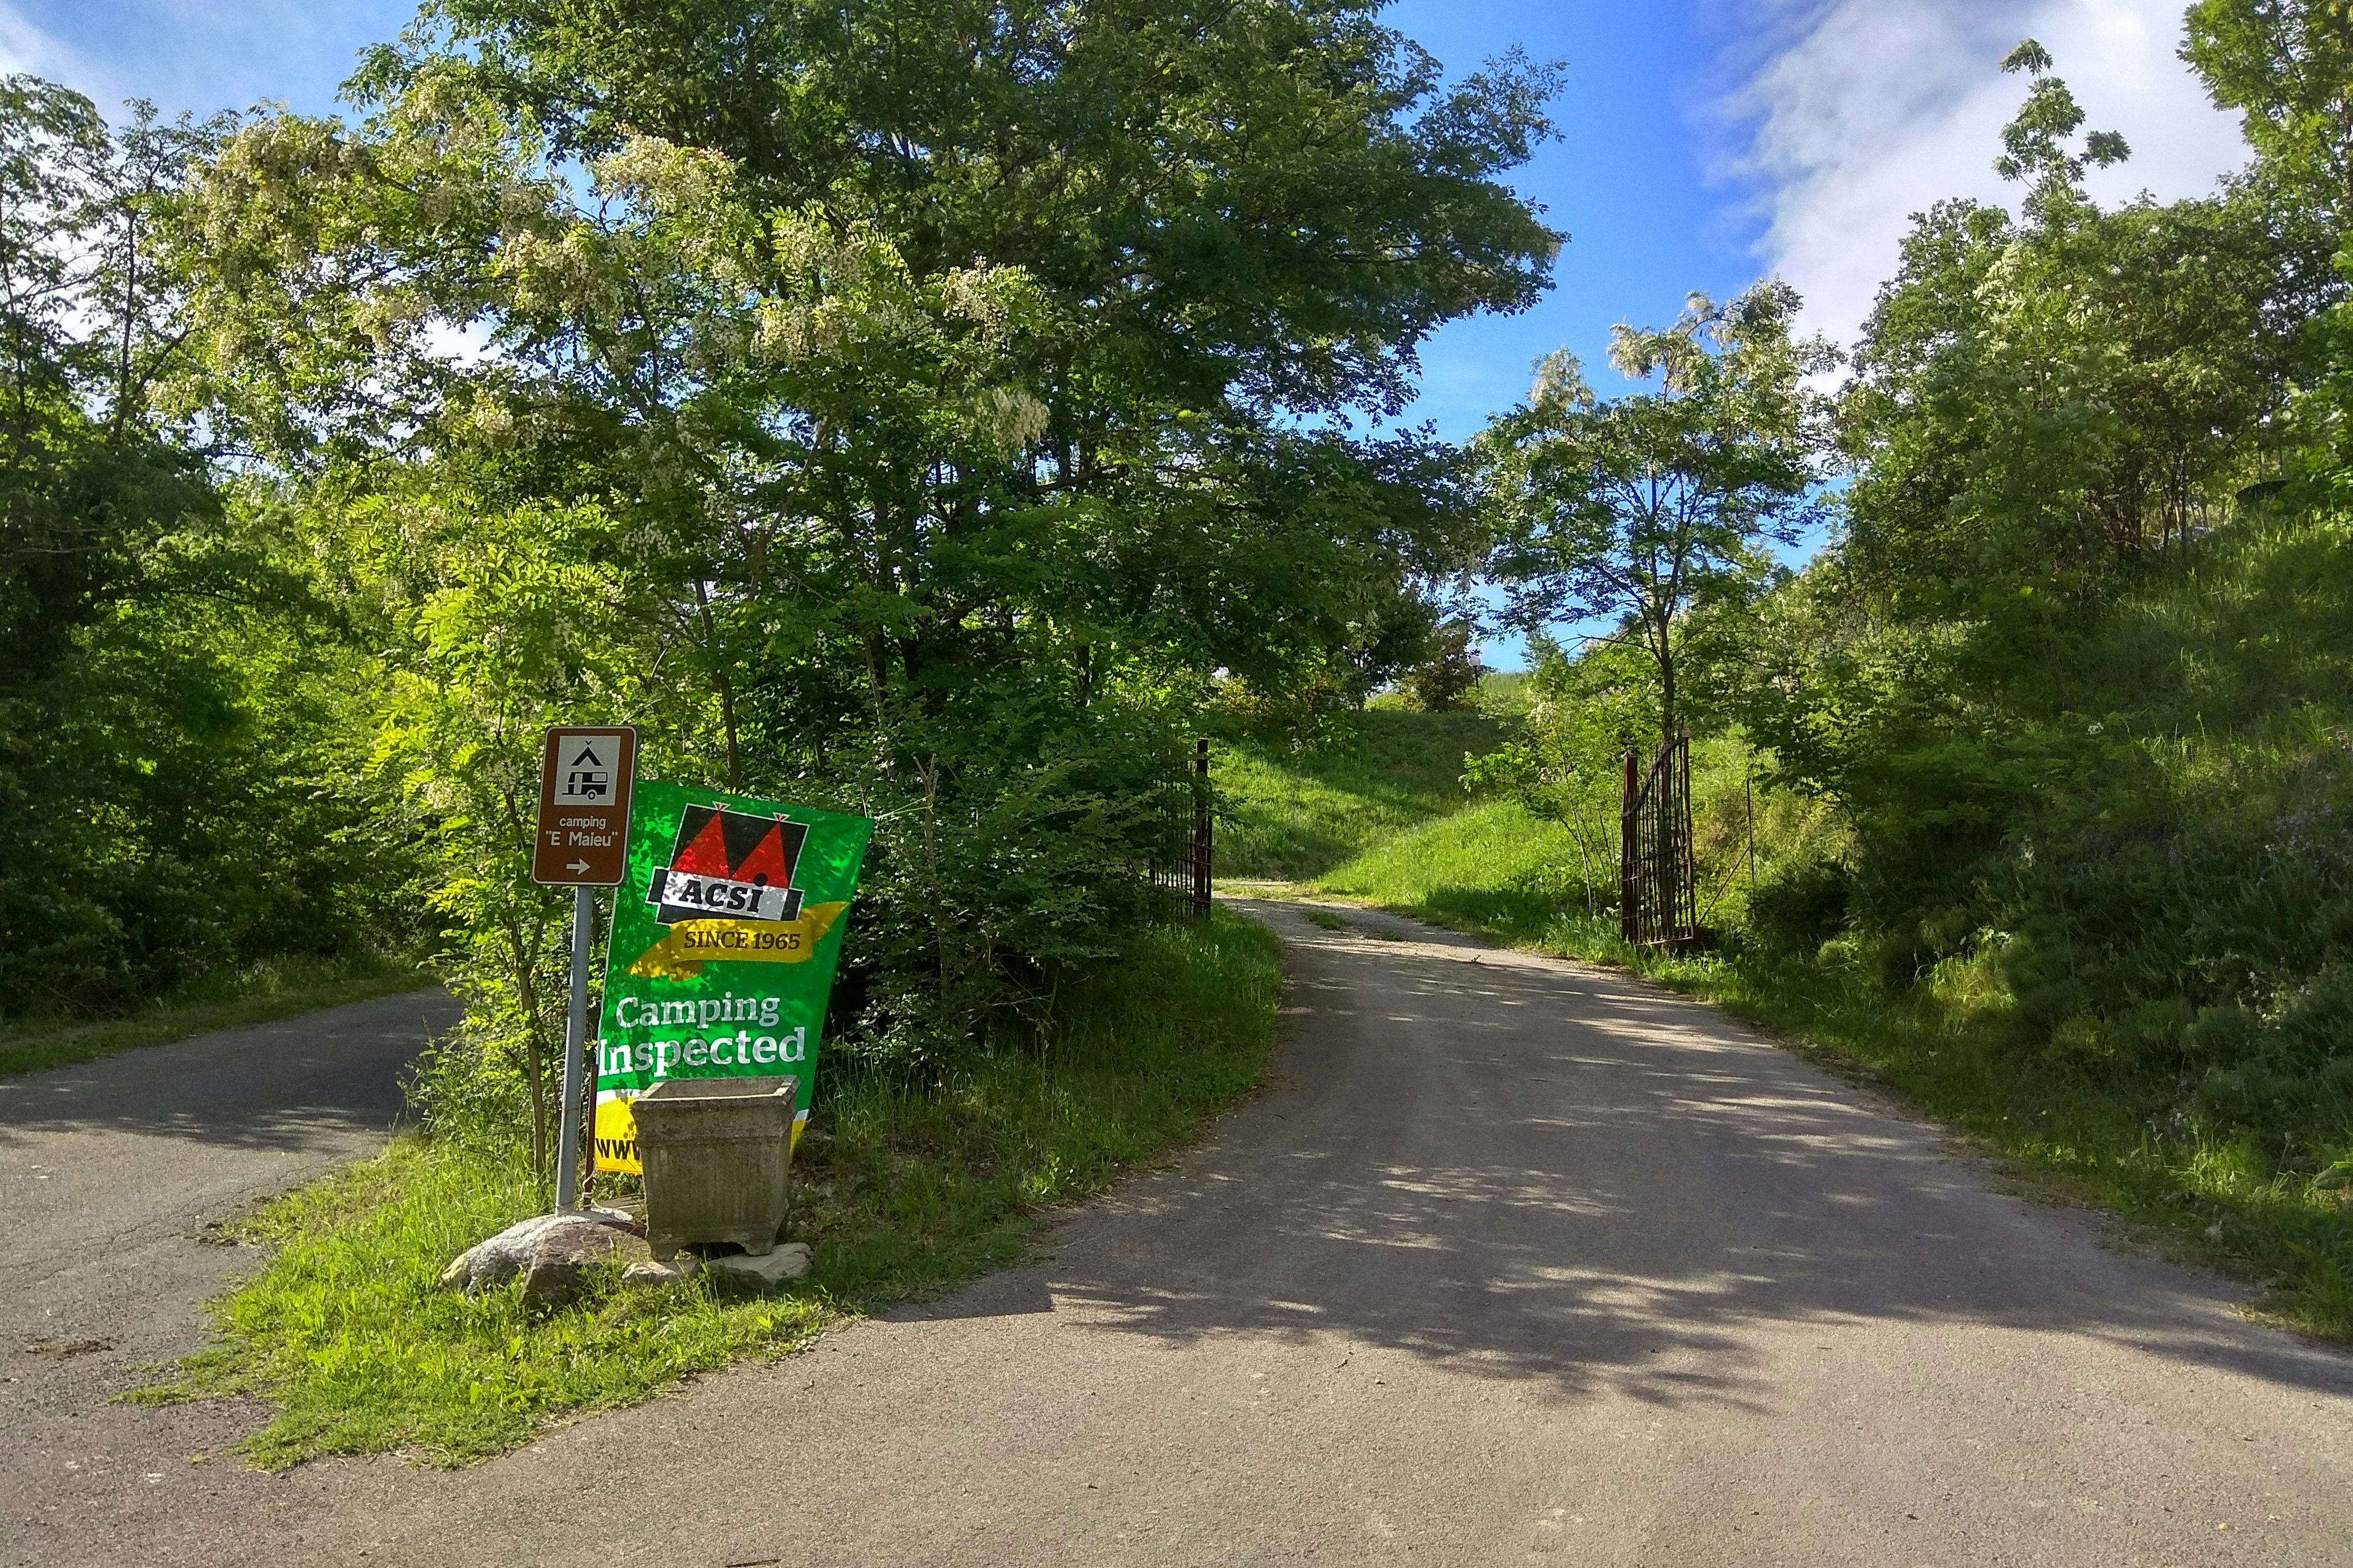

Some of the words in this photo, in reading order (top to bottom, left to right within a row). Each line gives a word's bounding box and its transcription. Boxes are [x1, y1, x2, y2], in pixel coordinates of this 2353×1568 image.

[559, 816, 606, 830] camping
[678, 873, 768, 913] ACSI
[683, 931, 749, 949] SINCE
[753, 932, 801, 950] 1965
[615, 991, 781, 1029] Camping
[598, 1027, 805, 1077] Inspected
